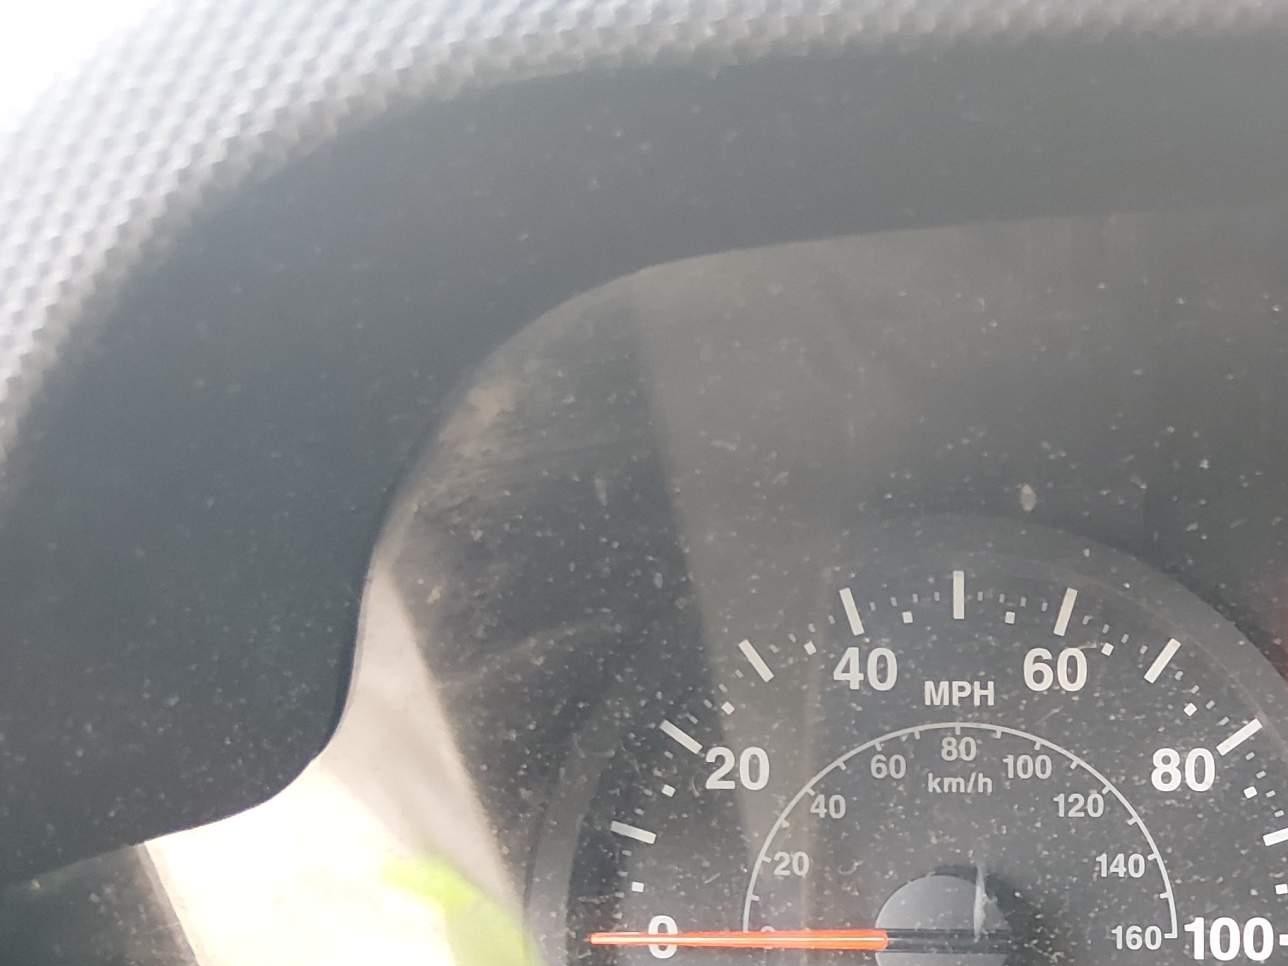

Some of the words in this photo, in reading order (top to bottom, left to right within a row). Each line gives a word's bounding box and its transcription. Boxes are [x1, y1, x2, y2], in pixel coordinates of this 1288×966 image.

[834, 648, 898, 690] 40
[1024, 648, 1088, 691] 60
[924, 682, 995, 706] MPH
[941, 738, 976, 762] 80
[705, 746, 770, 789] 20
[871, 756, 906, 780] 60
[1004, 756, 1052, 780] 100
[1152, 748, 1215, 791] 80
[927, 770, 993, 794] km/h
[810, 795, 846, 819] 40
[1055, 794, 1104, 818] 120
[774, 854, 810, 877] 20
[1097, 855, 1146, 878] 140
[647, 916, 679, 959] 0
[1112, 927, 1162, 949] 160
[1185, 918, 1275, 961] 100
